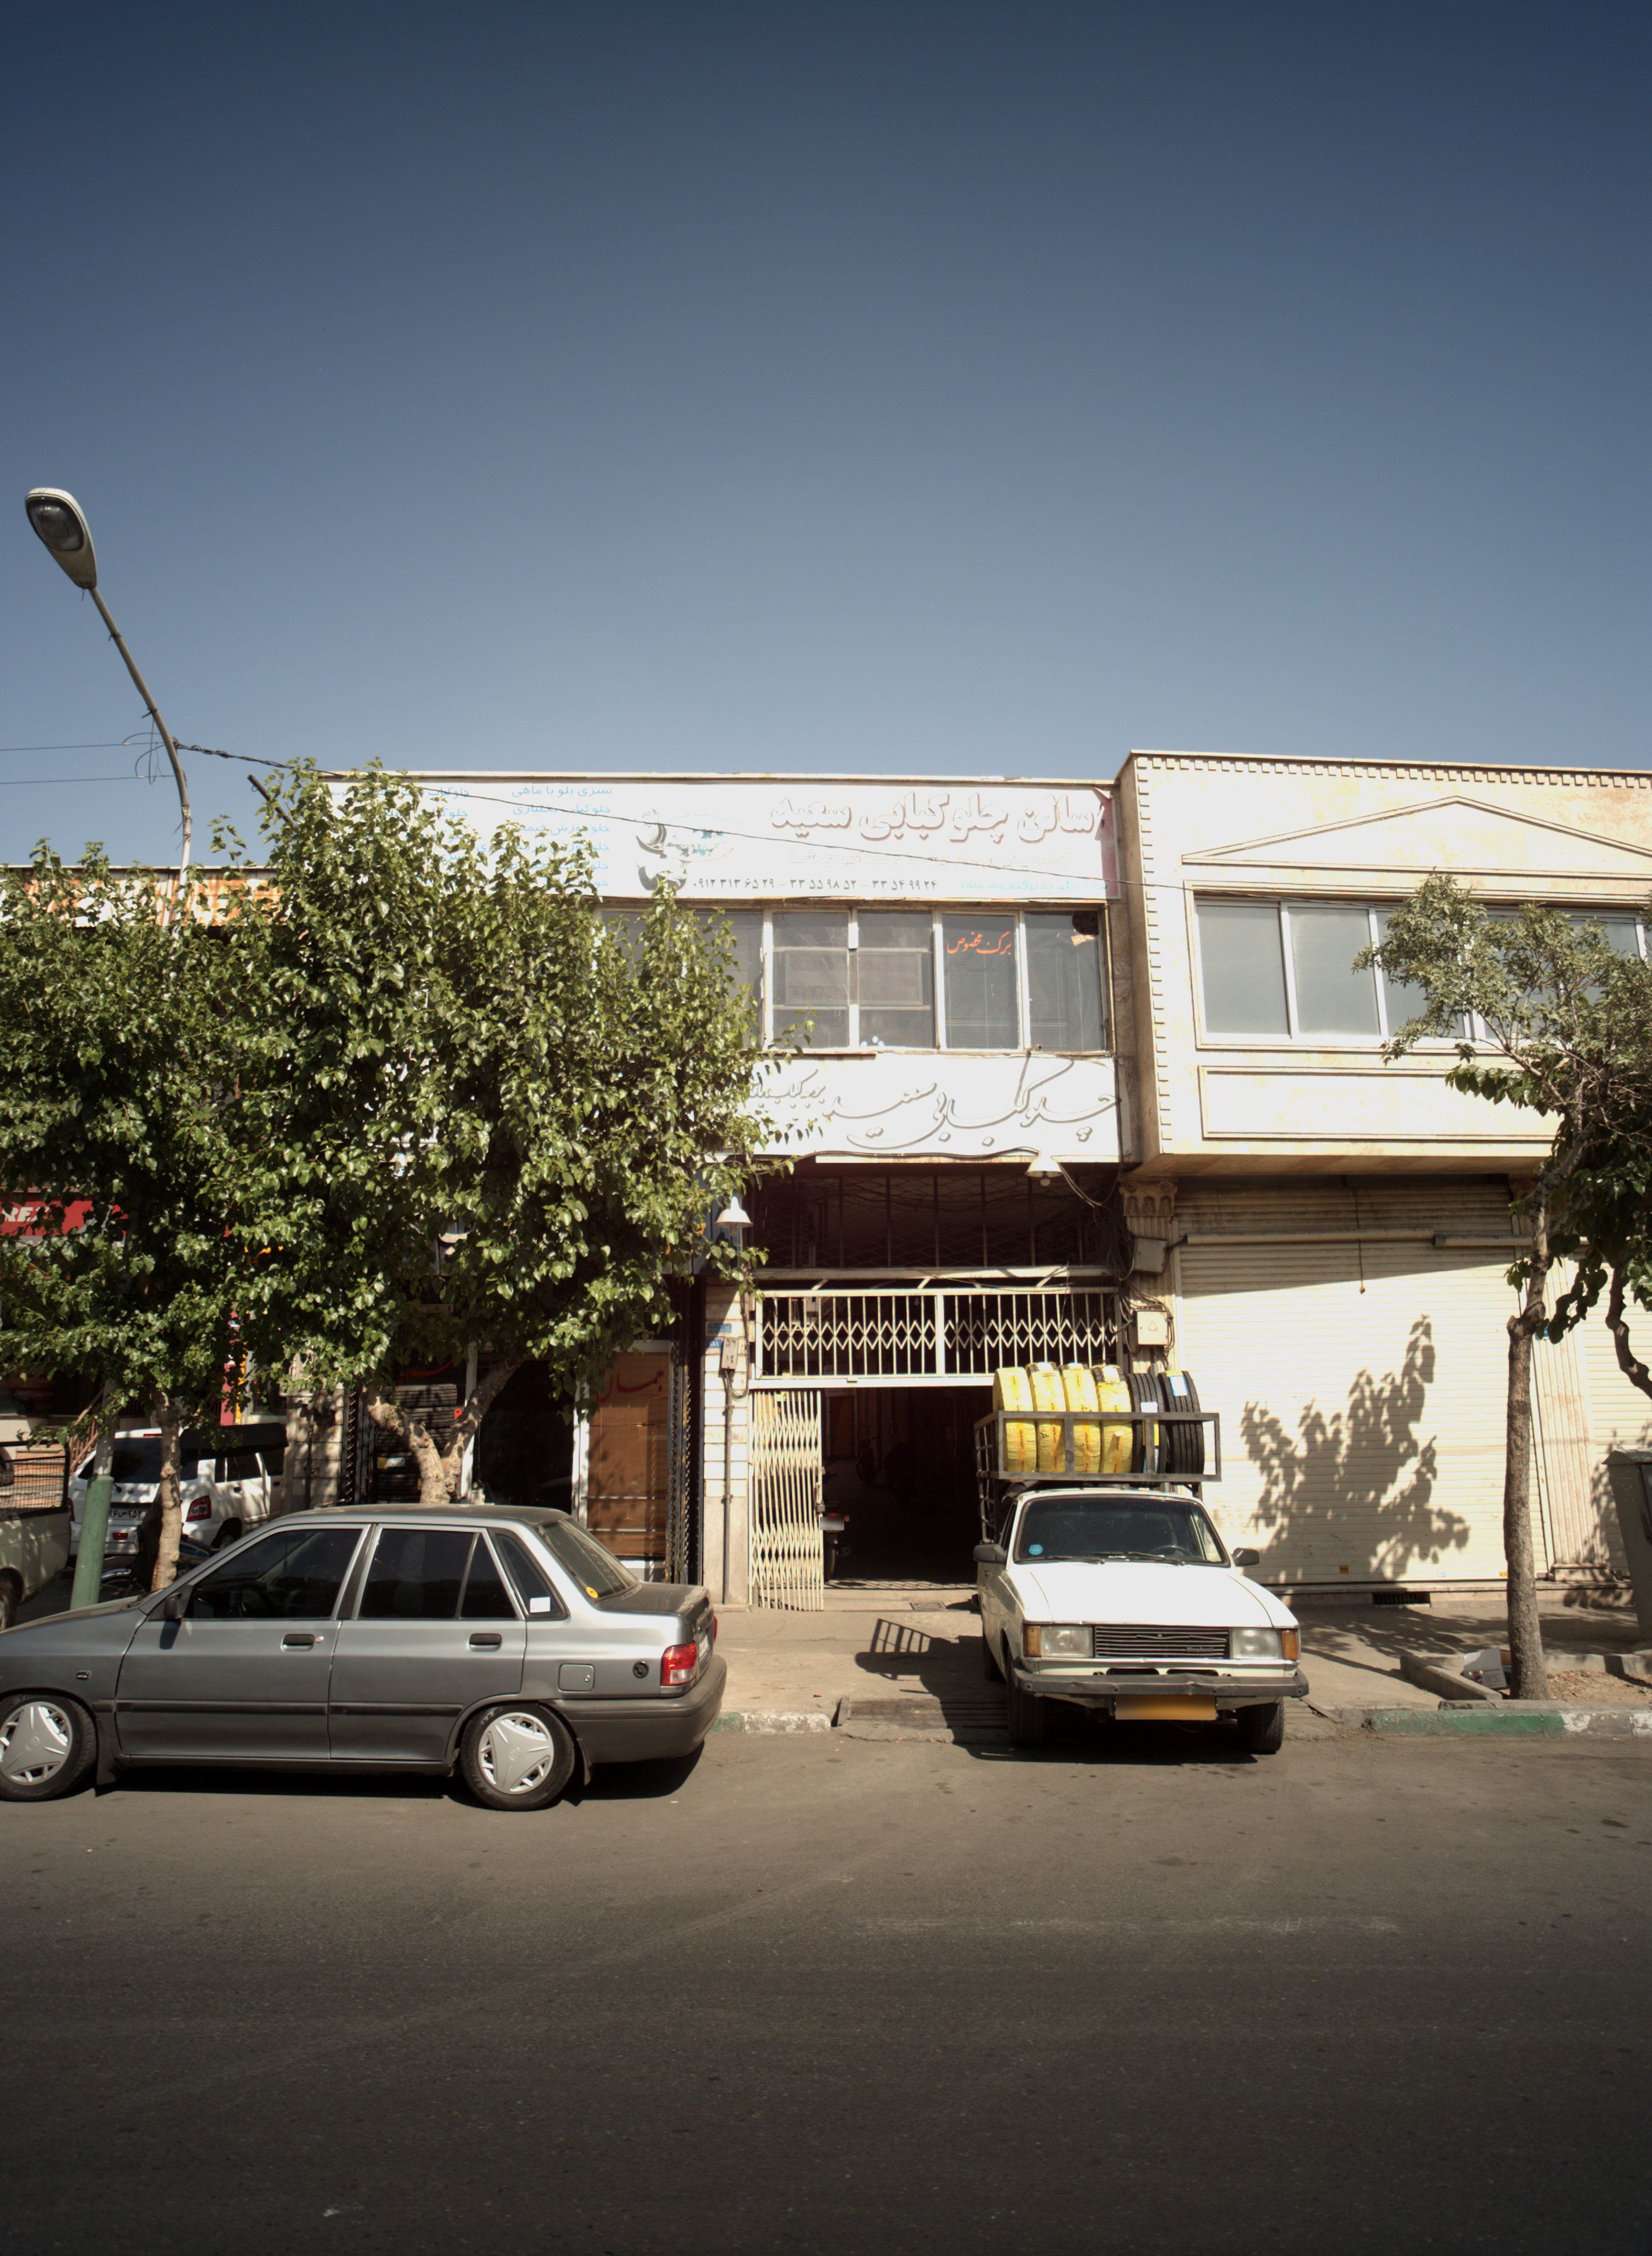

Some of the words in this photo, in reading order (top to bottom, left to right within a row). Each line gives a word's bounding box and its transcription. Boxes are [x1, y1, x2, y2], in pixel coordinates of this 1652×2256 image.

[512, 786, 542, 798] ماهی
[770, 797, 852, 838] سعید
[1017, 793, 1095, 843] سالن
[959, 880, 983, 891] شود
[947, 930, 983, 955] مخصوص
[822, 1082, 937, 1138] سعید
